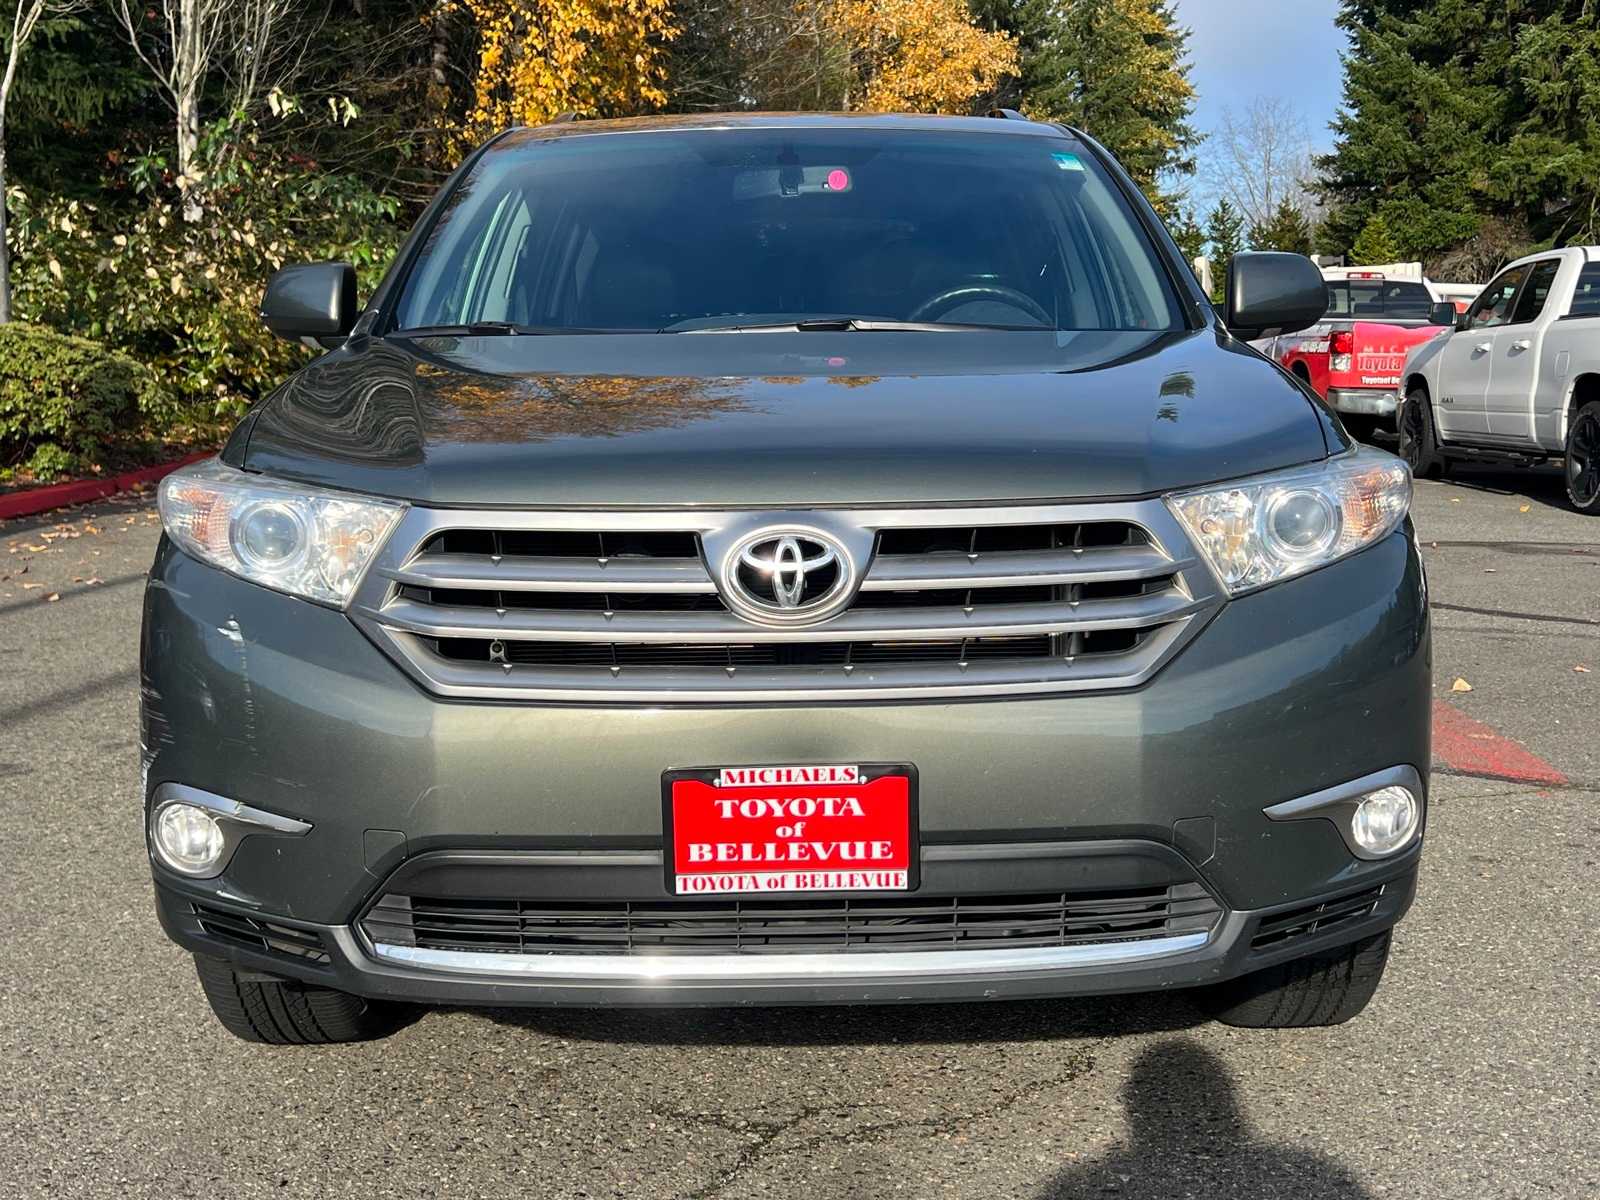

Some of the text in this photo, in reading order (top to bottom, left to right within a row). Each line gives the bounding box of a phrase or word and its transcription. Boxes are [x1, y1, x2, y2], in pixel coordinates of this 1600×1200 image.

[1357, 352, 1407, 373] Toyota
[724, 767, 856, 785] MICHAELS
[714, 797, 866, 819] TOYOTA
[775, 821, 806, 838] of
[687, 840, 894, 862] BELLEVUE
[678, 872, 906, 892] TOYOTA of BELLEVUE
